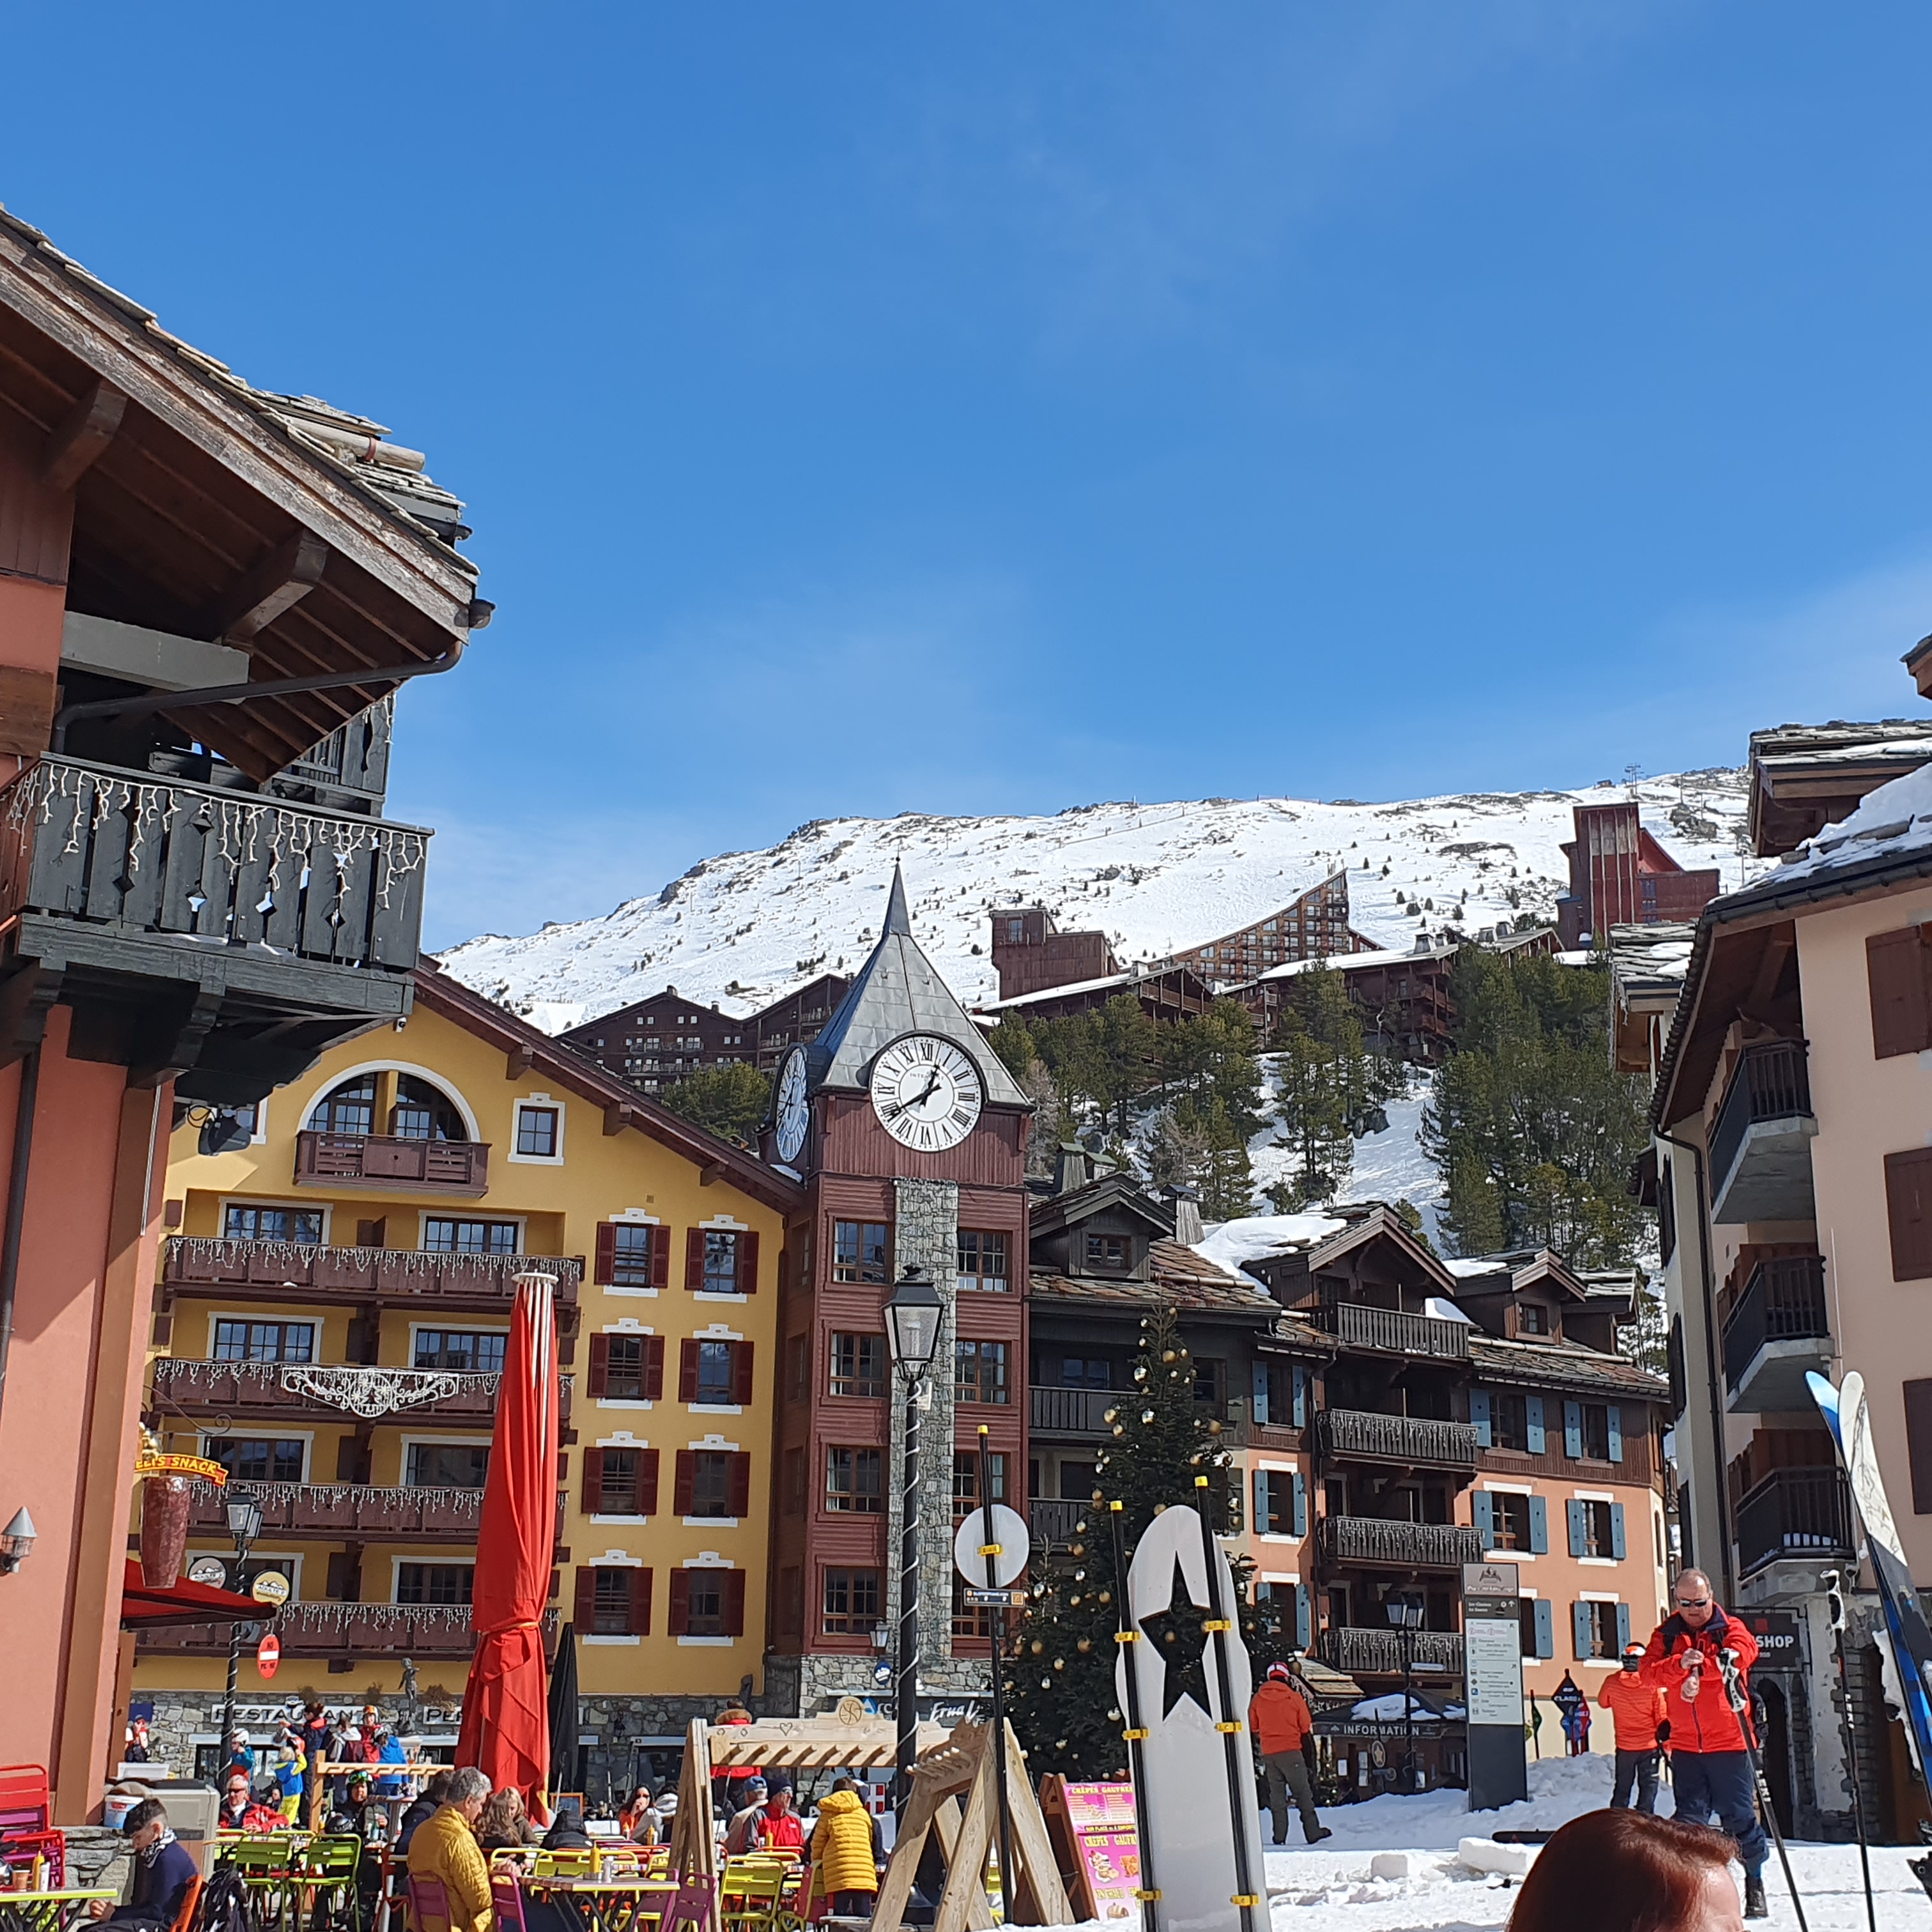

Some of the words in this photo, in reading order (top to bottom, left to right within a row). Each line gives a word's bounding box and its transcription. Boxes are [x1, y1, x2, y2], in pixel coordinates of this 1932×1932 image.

[171, 1457, 217, 1474] SNACK
[1756, 1635, 1794, 1648] SHOP
[1844, 1693, 1854, 1729] LEKI
[1755, 1769, 1771, 1802] LEKI
